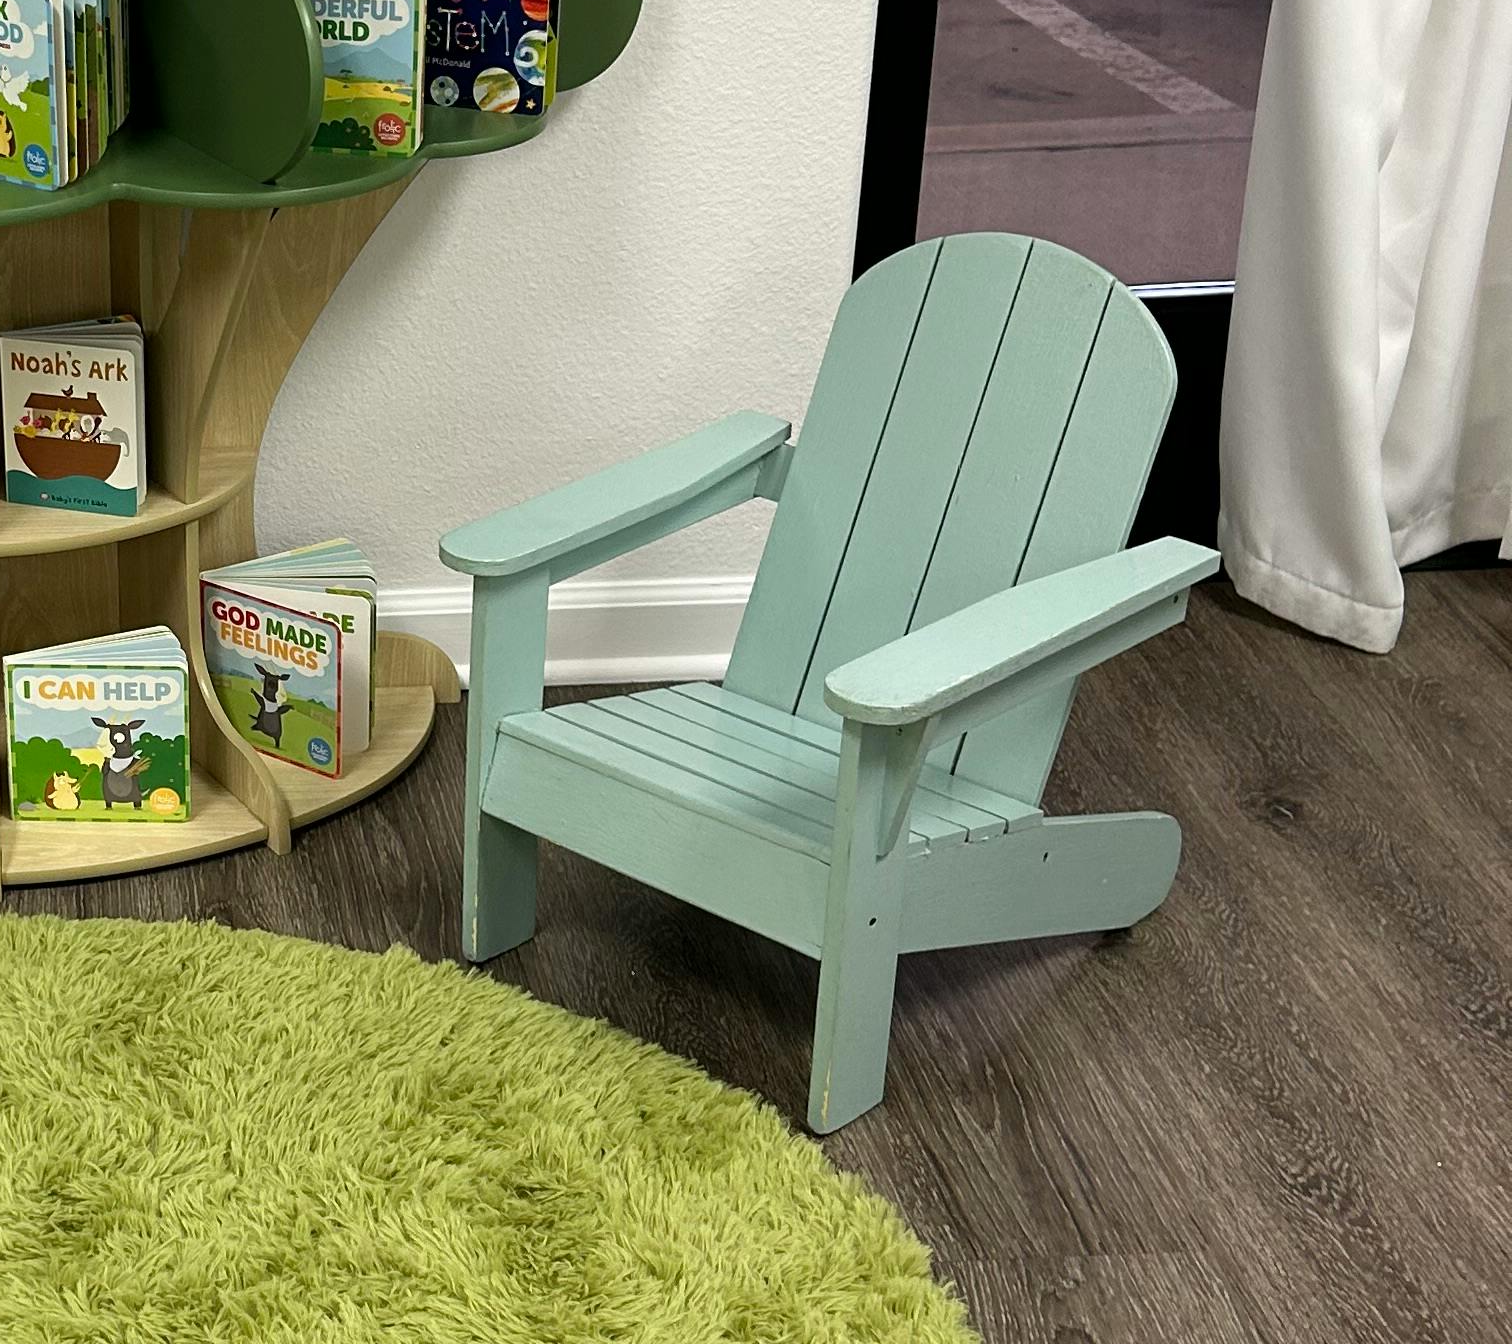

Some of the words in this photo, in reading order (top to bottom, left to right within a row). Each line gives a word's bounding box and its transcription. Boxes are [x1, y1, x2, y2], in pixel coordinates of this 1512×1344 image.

[316, 20, 370, 42] RLD
[11, 350, 81, 377] Noah's
[88, 358, 128, 381] Ark
[212, 601, 260, 631] GOD
[266, 617, 327, 655] MADE
[221, 622, 318, 671] FEELINGS
[24, 680, 30, 699] I
[39, 680, 95, 700] CAN
[103, 681, 171, 701] HELP
